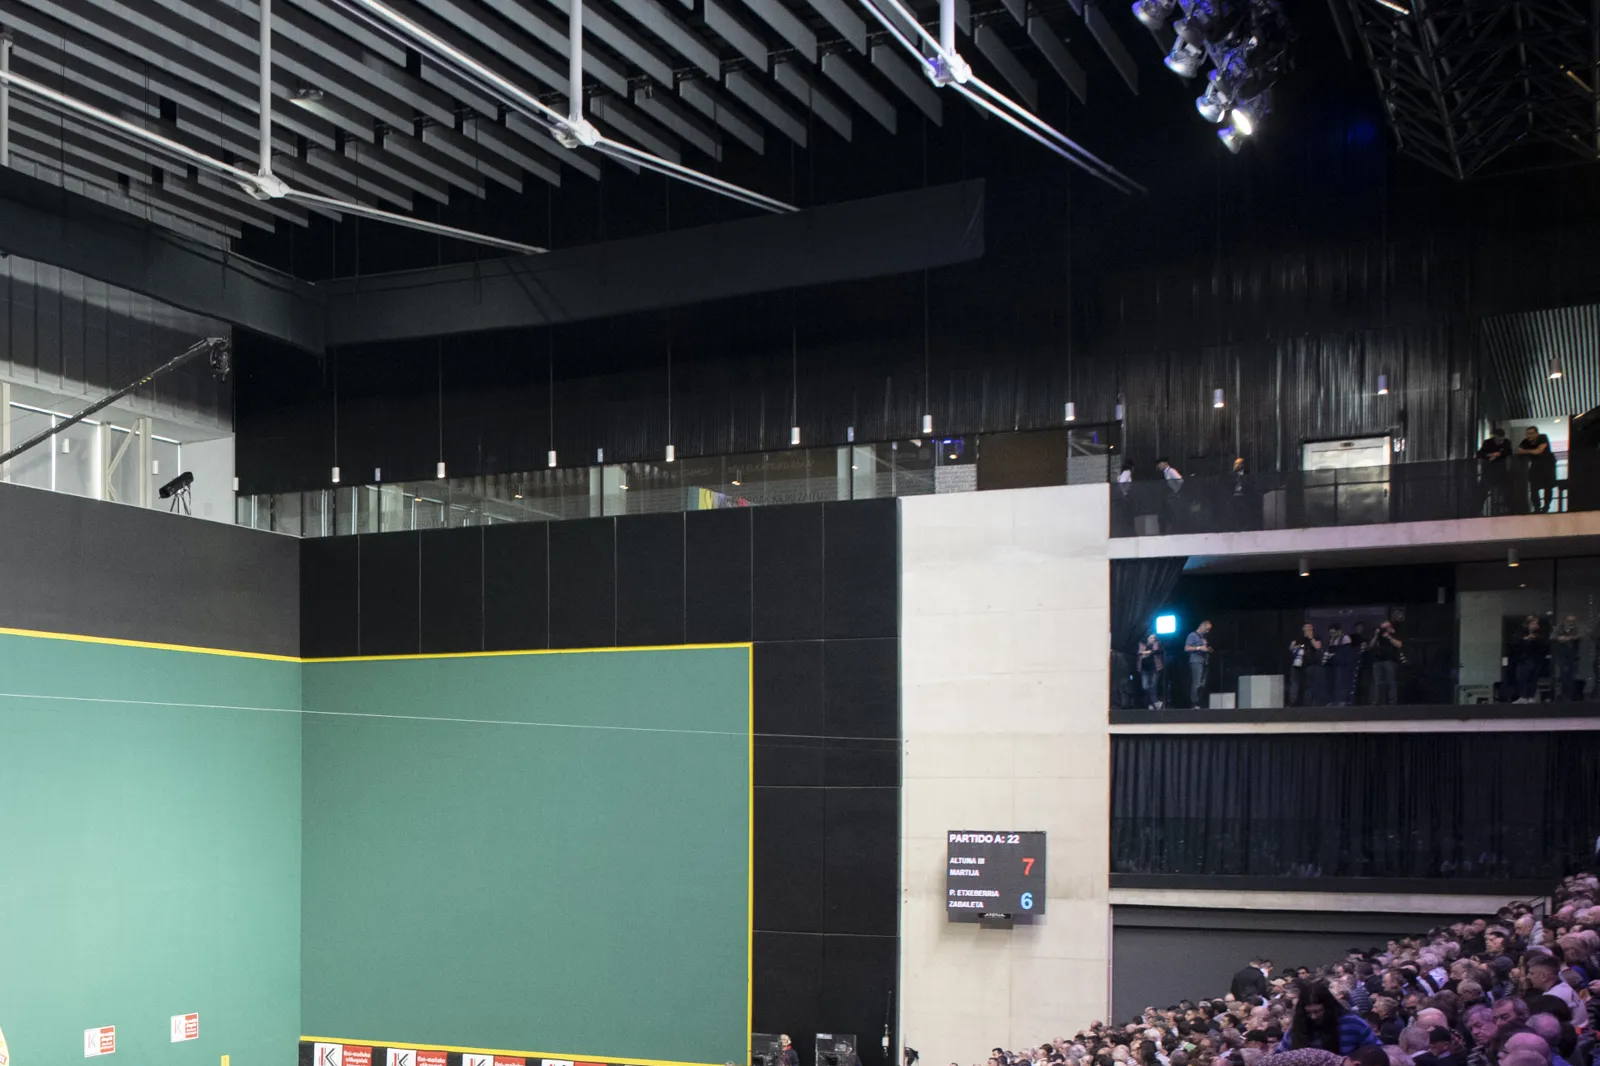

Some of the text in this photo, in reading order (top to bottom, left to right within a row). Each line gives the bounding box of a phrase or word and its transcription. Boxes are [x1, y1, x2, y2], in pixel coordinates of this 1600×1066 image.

[949, 834, 1020, 844] PARTIDO A: 22
[1022, 858, 1035, 876] 7
[956, 890, 1000, 898] ETXEBERRIA
[948, 900, 984, 908] ZABALETA
[1020, 892, 1034, 910] 6
